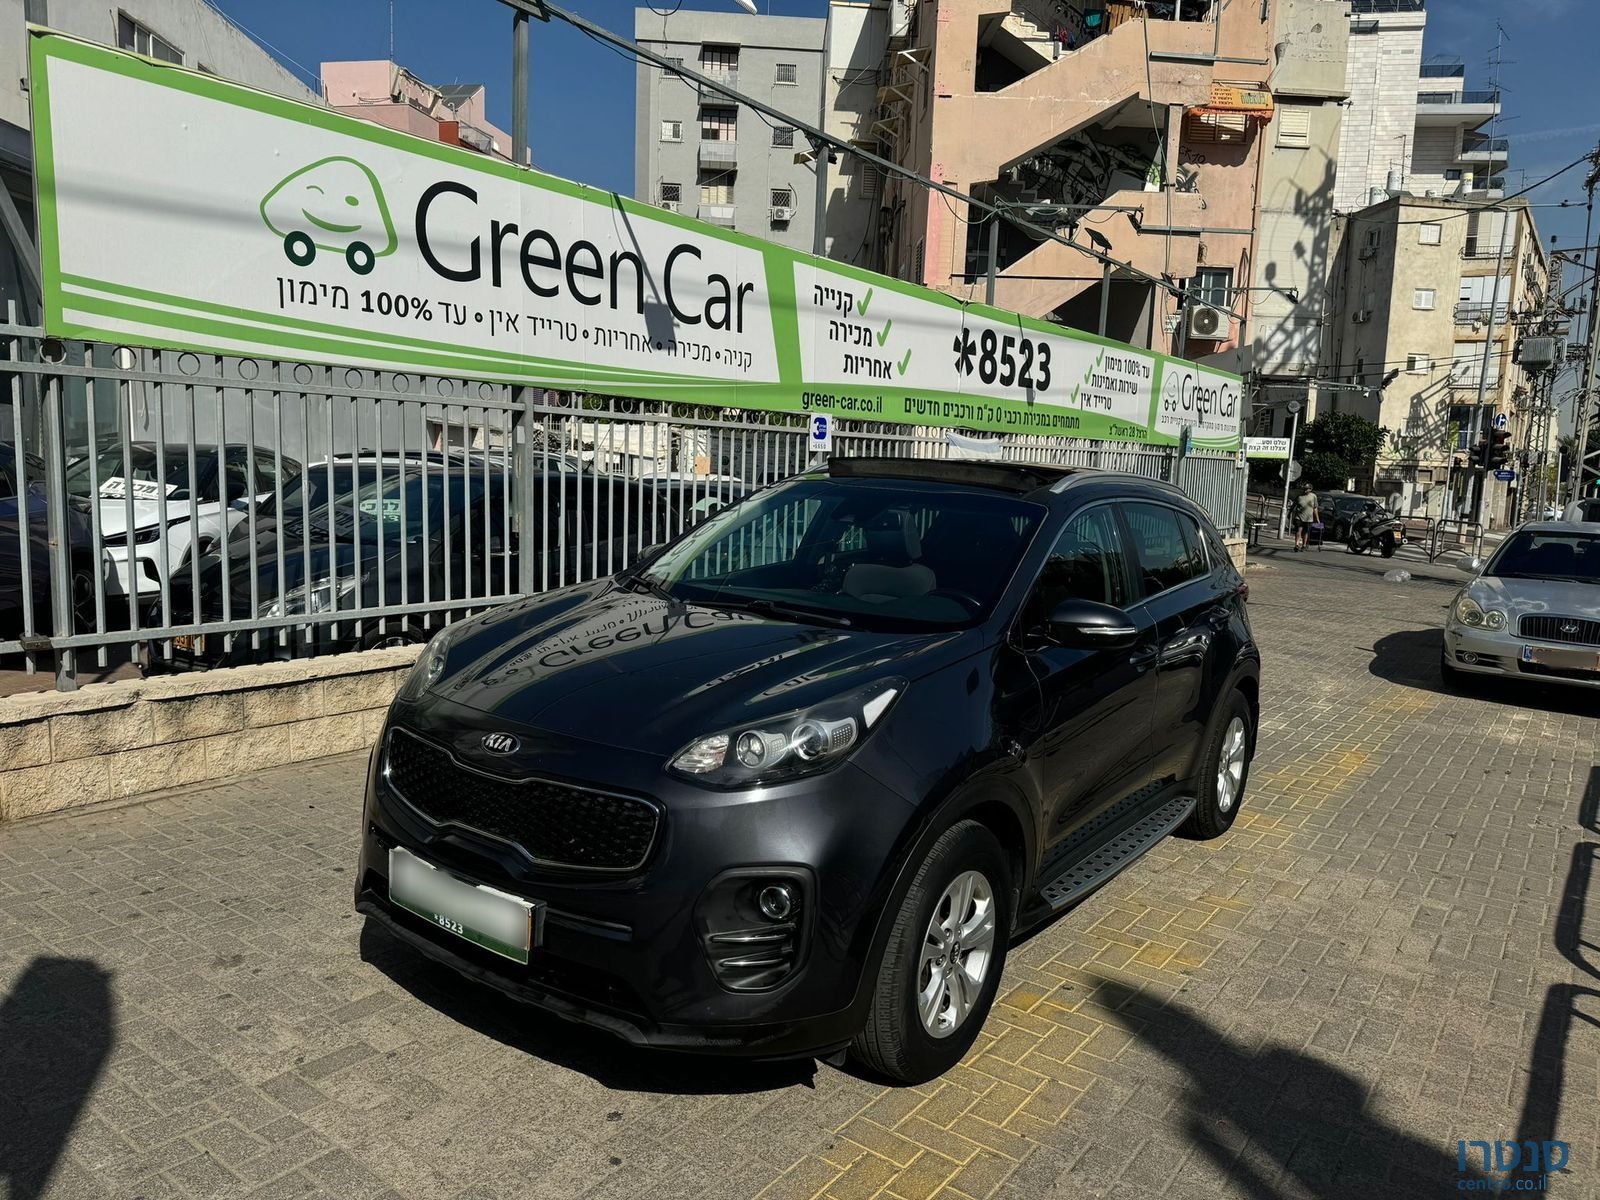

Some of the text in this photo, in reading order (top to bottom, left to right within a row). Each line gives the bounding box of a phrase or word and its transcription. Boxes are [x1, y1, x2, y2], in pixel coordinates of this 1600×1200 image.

[415, 181, 754, 333] Green Car
[814, 284, 853, 318] קנייה
[277, 277, 752, 372] קניה מכירה אחריות טרייד אין עד 100% מימון
[829, 320, 872, 347] מכירה
[843, 354, 892, 379] אחריות
[1105, 355, 1122, 373] מימון
[802, 391, 883, 413] green-car.co.il
[904, 397, 940, 416] חדשים
[1081, 393, 1091, 411] אין
[1182, 373, 1238, 418] Green Car
[943, 402, 973, 420] ורכבים
[1004, 410, 1021, 424] רכבי
[485, 734, 513, 751] KIA
